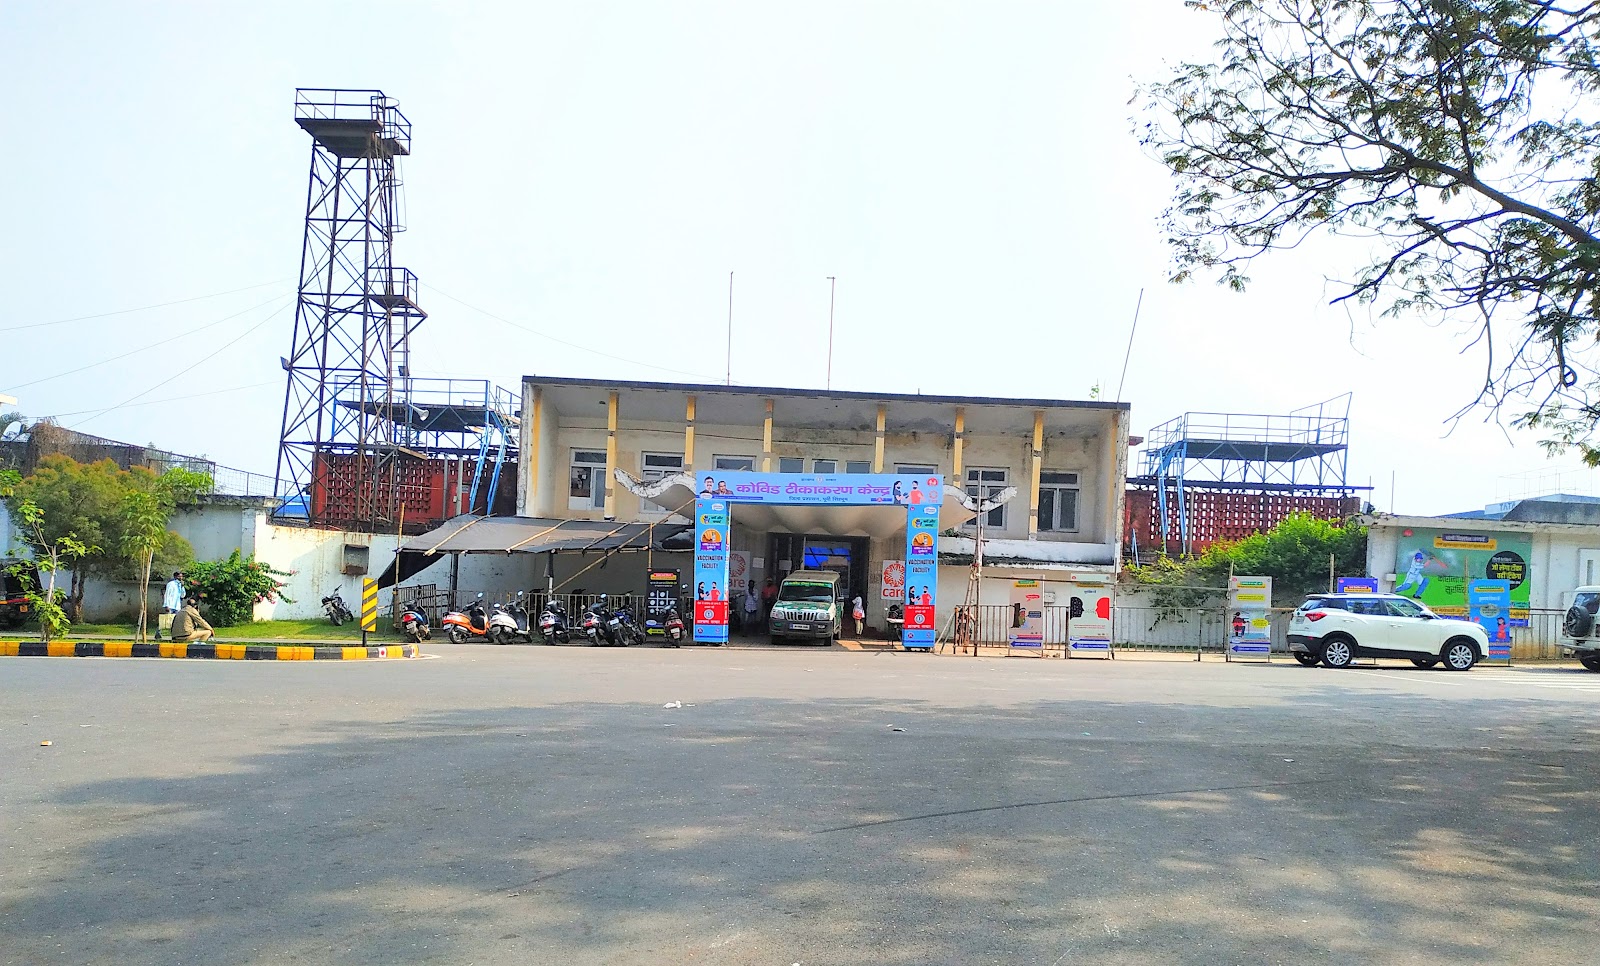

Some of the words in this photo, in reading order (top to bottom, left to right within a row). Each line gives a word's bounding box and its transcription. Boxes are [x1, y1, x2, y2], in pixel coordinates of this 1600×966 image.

[736, 481, 781, 495] कोविड
[785, 482, 854, 495] टीकाकरण
[857, 483, 891, 497] केन्द्र
